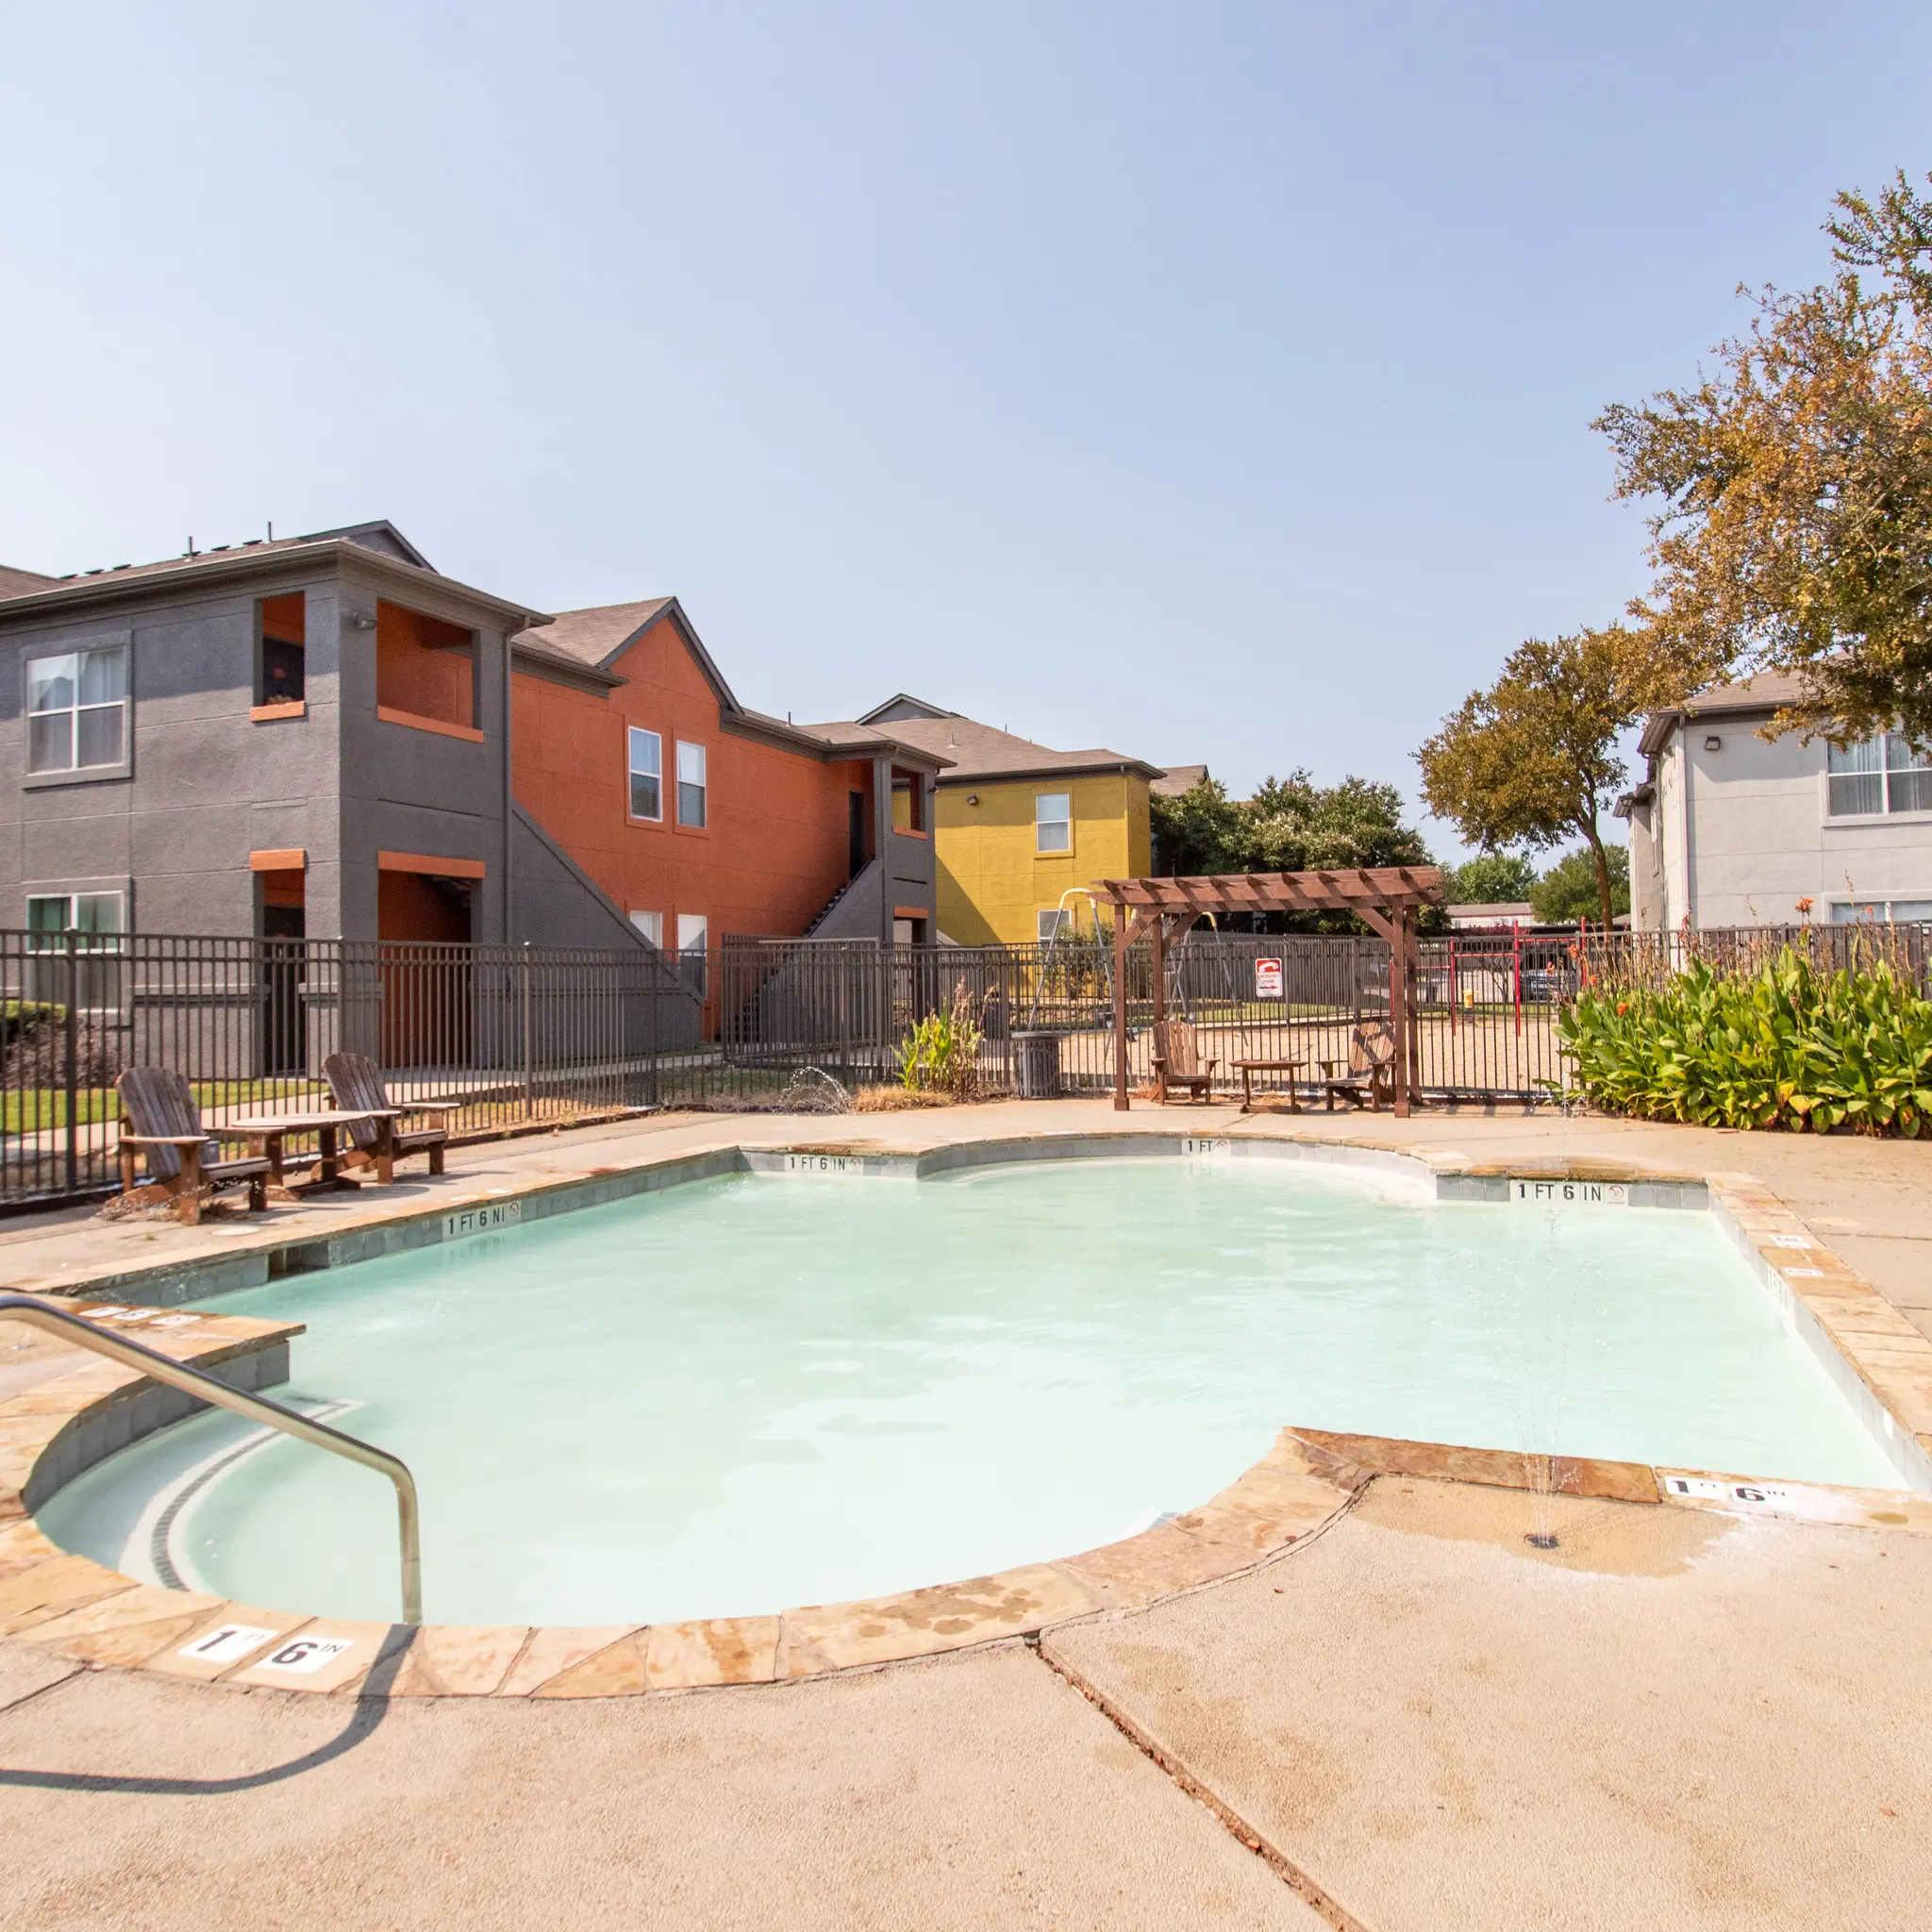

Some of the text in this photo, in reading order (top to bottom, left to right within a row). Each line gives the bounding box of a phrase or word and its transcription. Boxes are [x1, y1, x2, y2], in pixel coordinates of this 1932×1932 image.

[1187, 1140, 1213, 1153] 1 FT
[791, 1157, 845, 1171] 1 FT 6 IN
[1519, 1183, 1601, 1201] 1 FT 6 IN
[448, 1217, 454, 1234] 1
[460, 1213, 475, 1231] FT
[479, 1211, 487, 1226] 6
[1672, 1480, 1690, 1493] 1
[1735, 1488, 1765, 1502] 6
[196, 1630, 238, 1653] 1
[272, 1641, 318, 1664] 6
[320, 1643, 344, 1654] IN
